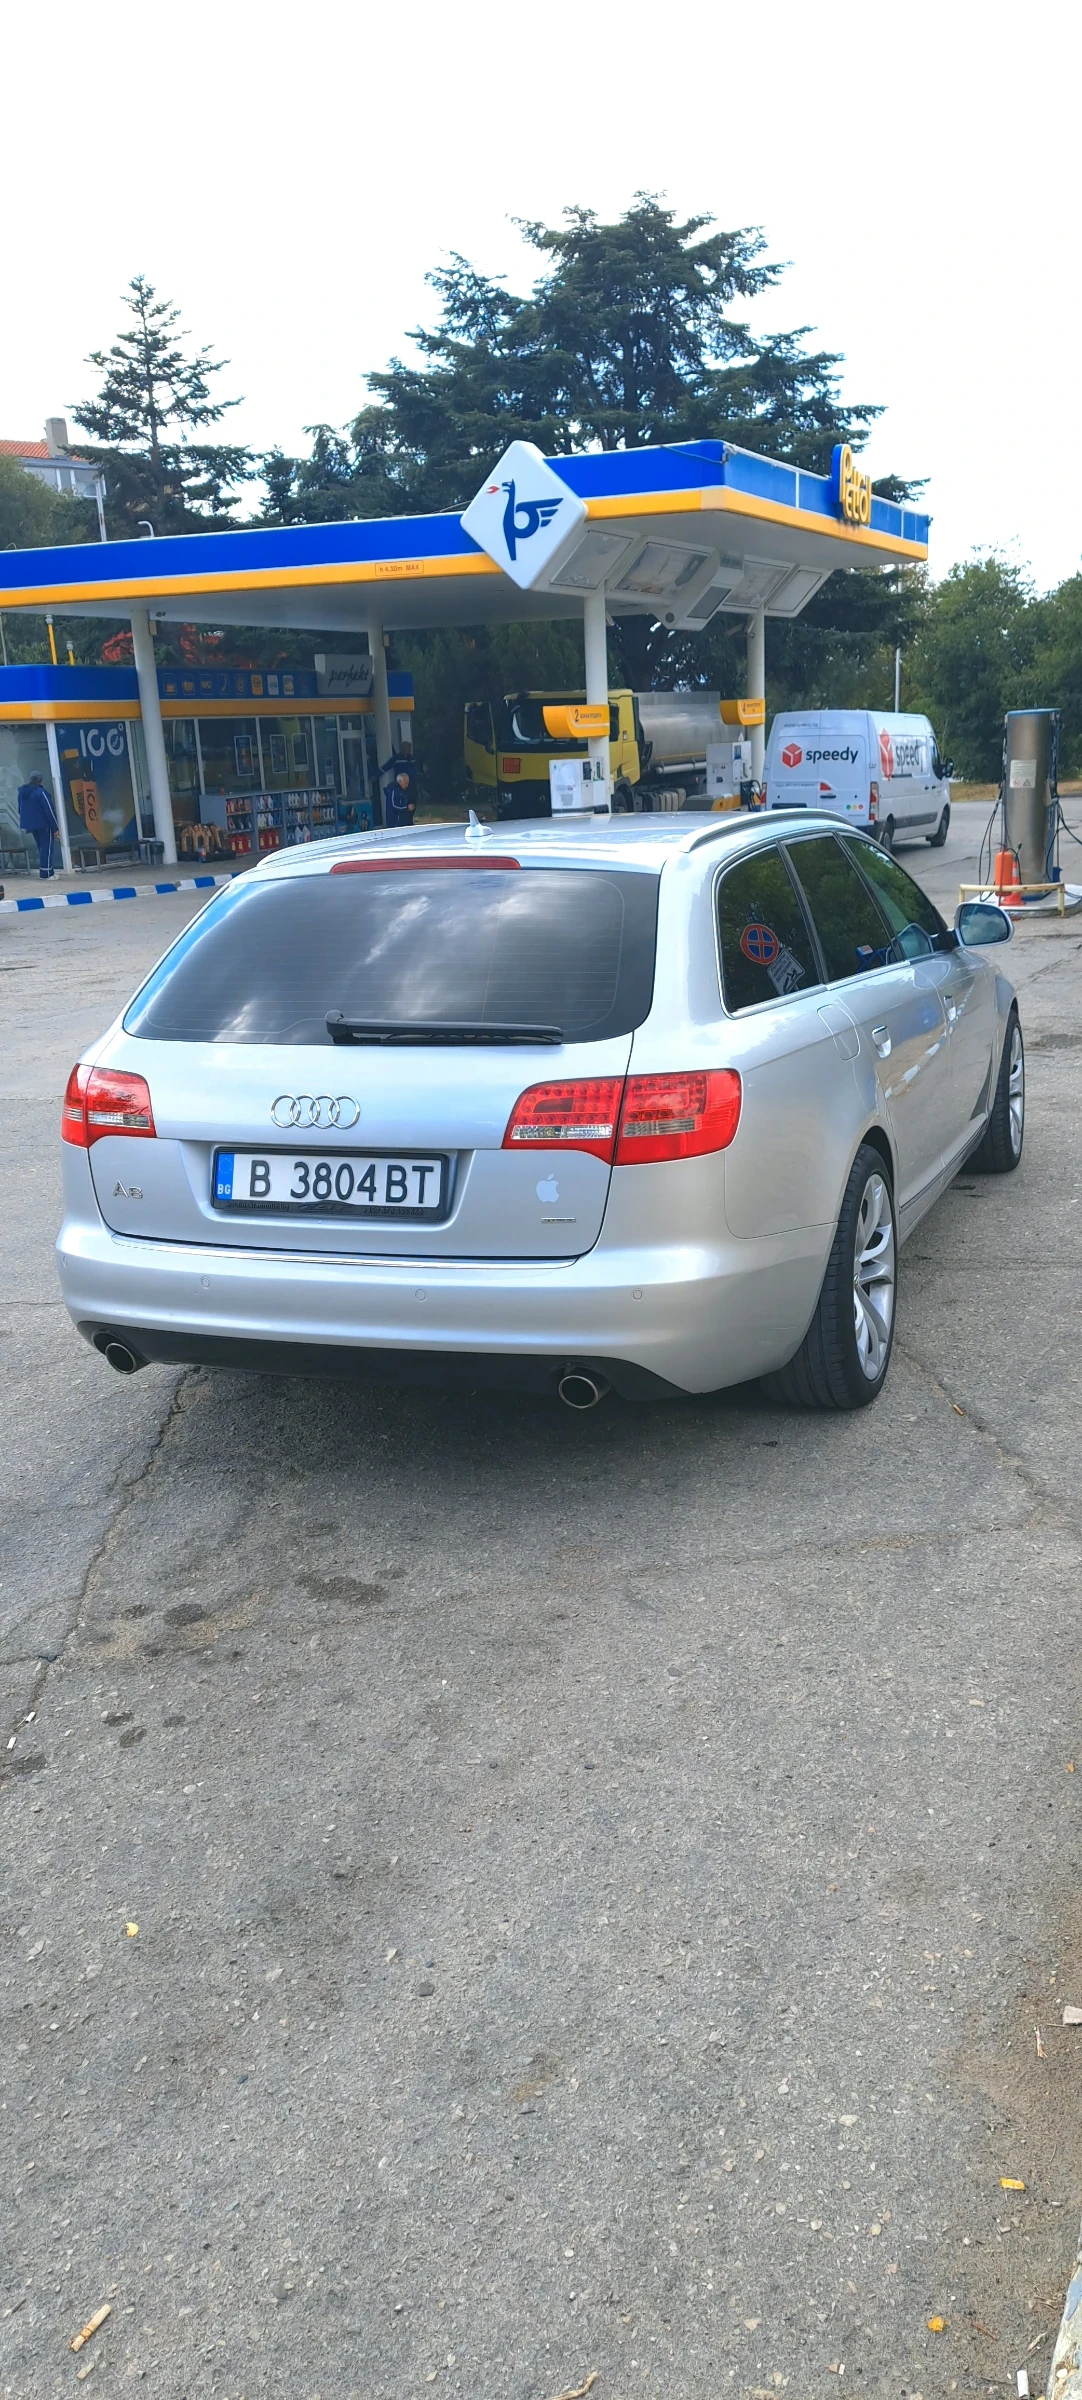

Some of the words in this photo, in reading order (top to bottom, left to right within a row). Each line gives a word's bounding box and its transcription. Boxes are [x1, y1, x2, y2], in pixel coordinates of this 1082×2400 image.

[574, 709, 579, 722] 2
[805, 746, 859, 764] speedy
[249, 1160, 271, 1197] B
[217, 1184, 231, 1195] BG
